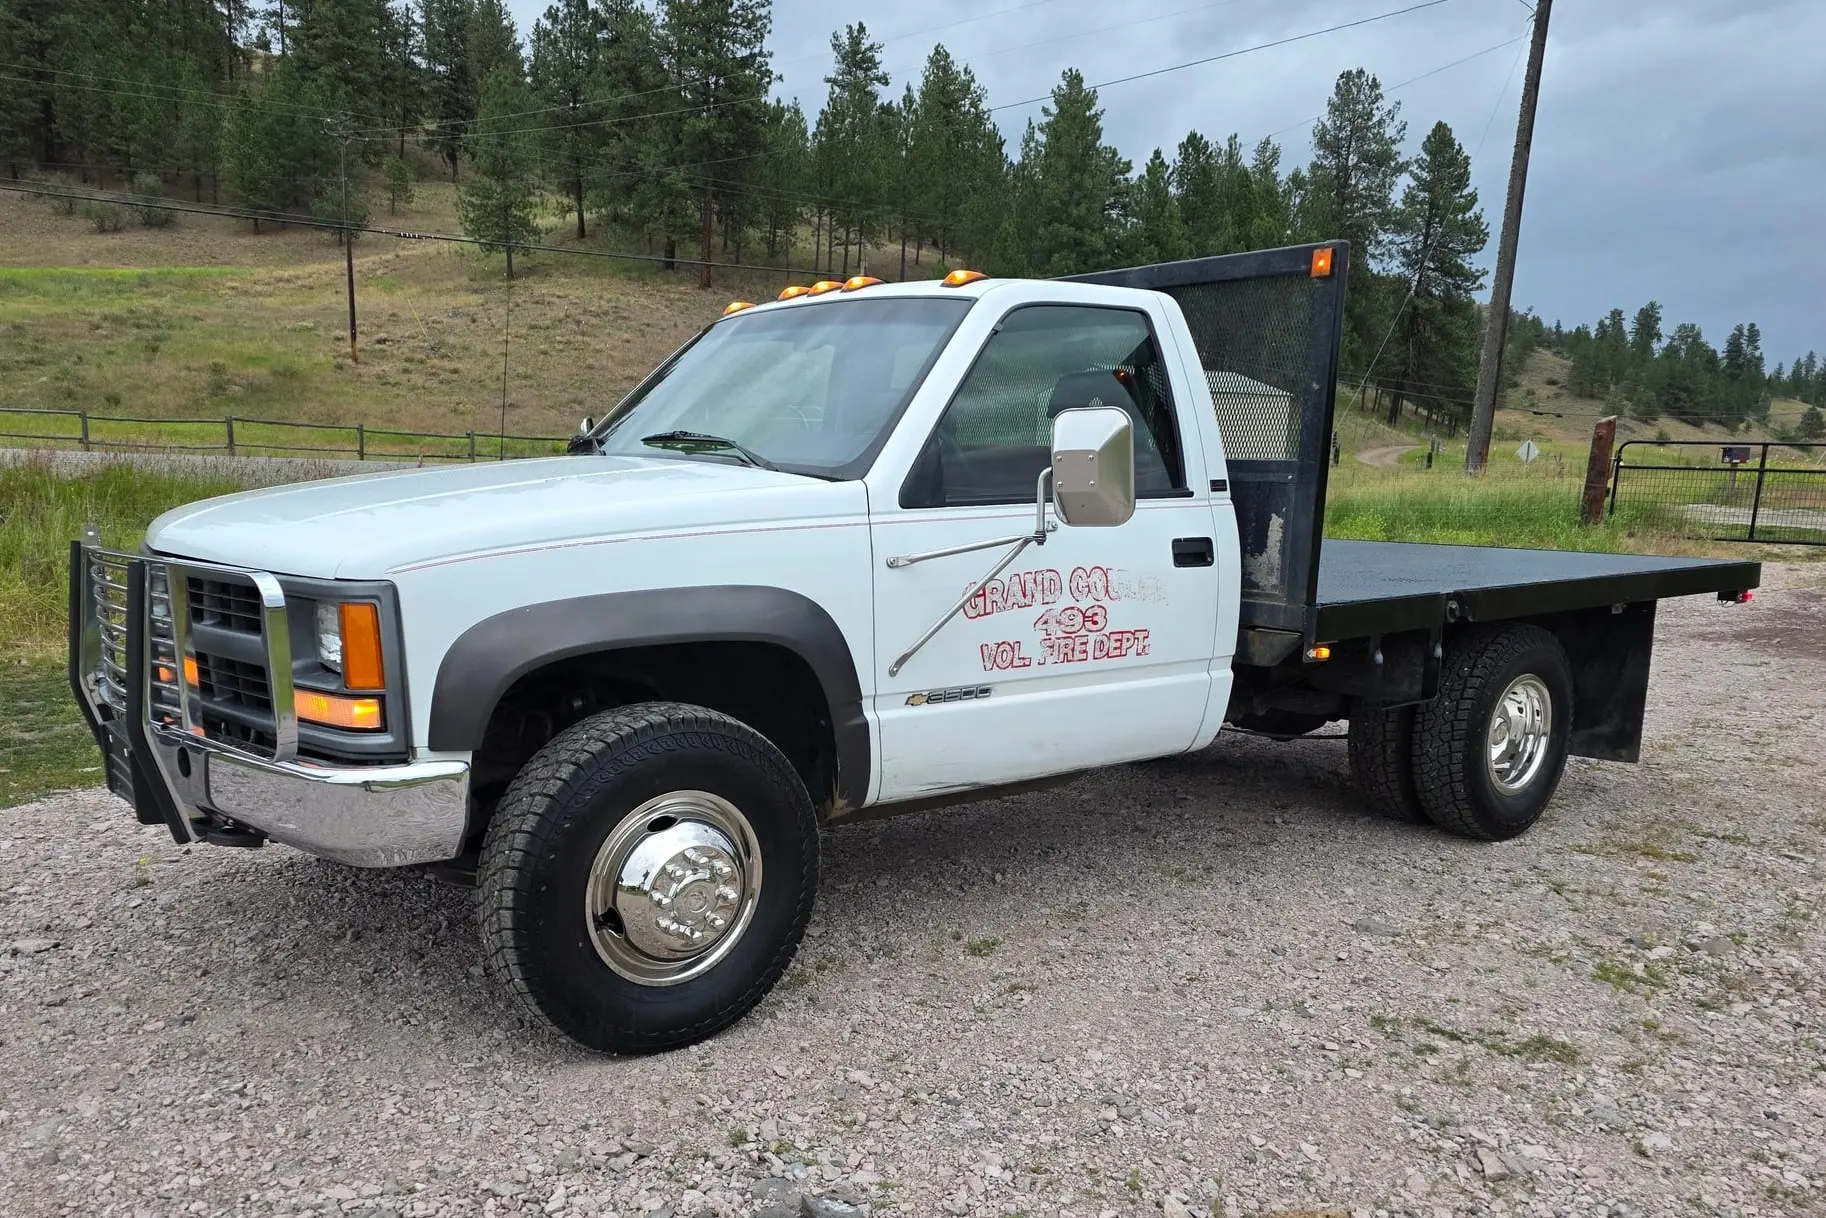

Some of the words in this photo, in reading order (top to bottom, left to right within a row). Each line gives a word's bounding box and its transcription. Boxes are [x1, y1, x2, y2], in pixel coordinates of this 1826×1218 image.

[962, 569, 1062, 619] GRAND
[1033, 605, 1107, 636] 493
[1038, 635, 1088, 665] FIRE
